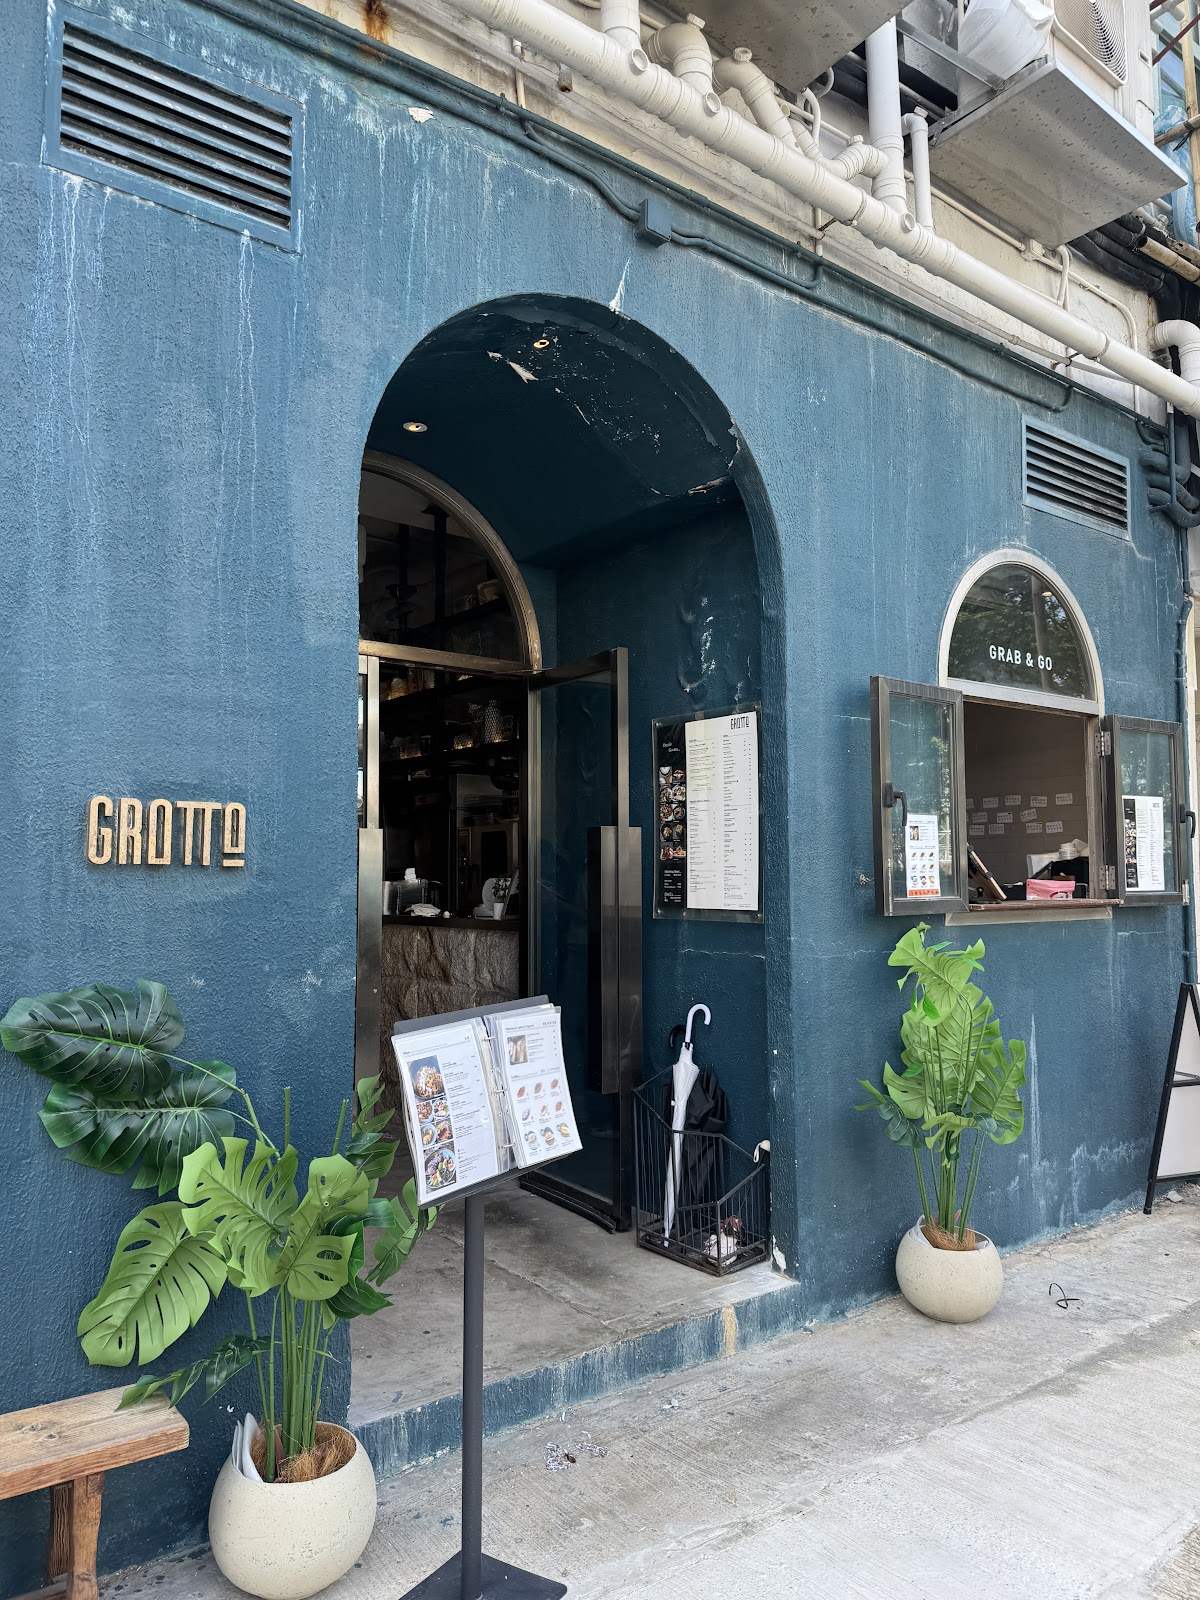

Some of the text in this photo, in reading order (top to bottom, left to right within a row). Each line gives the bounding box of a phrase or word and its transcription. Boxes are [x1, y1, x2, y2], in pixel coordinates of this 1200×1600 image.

[989, 644, 1053, 671] GRAB & GO
[87, 795, 247, 867] GROTTO
